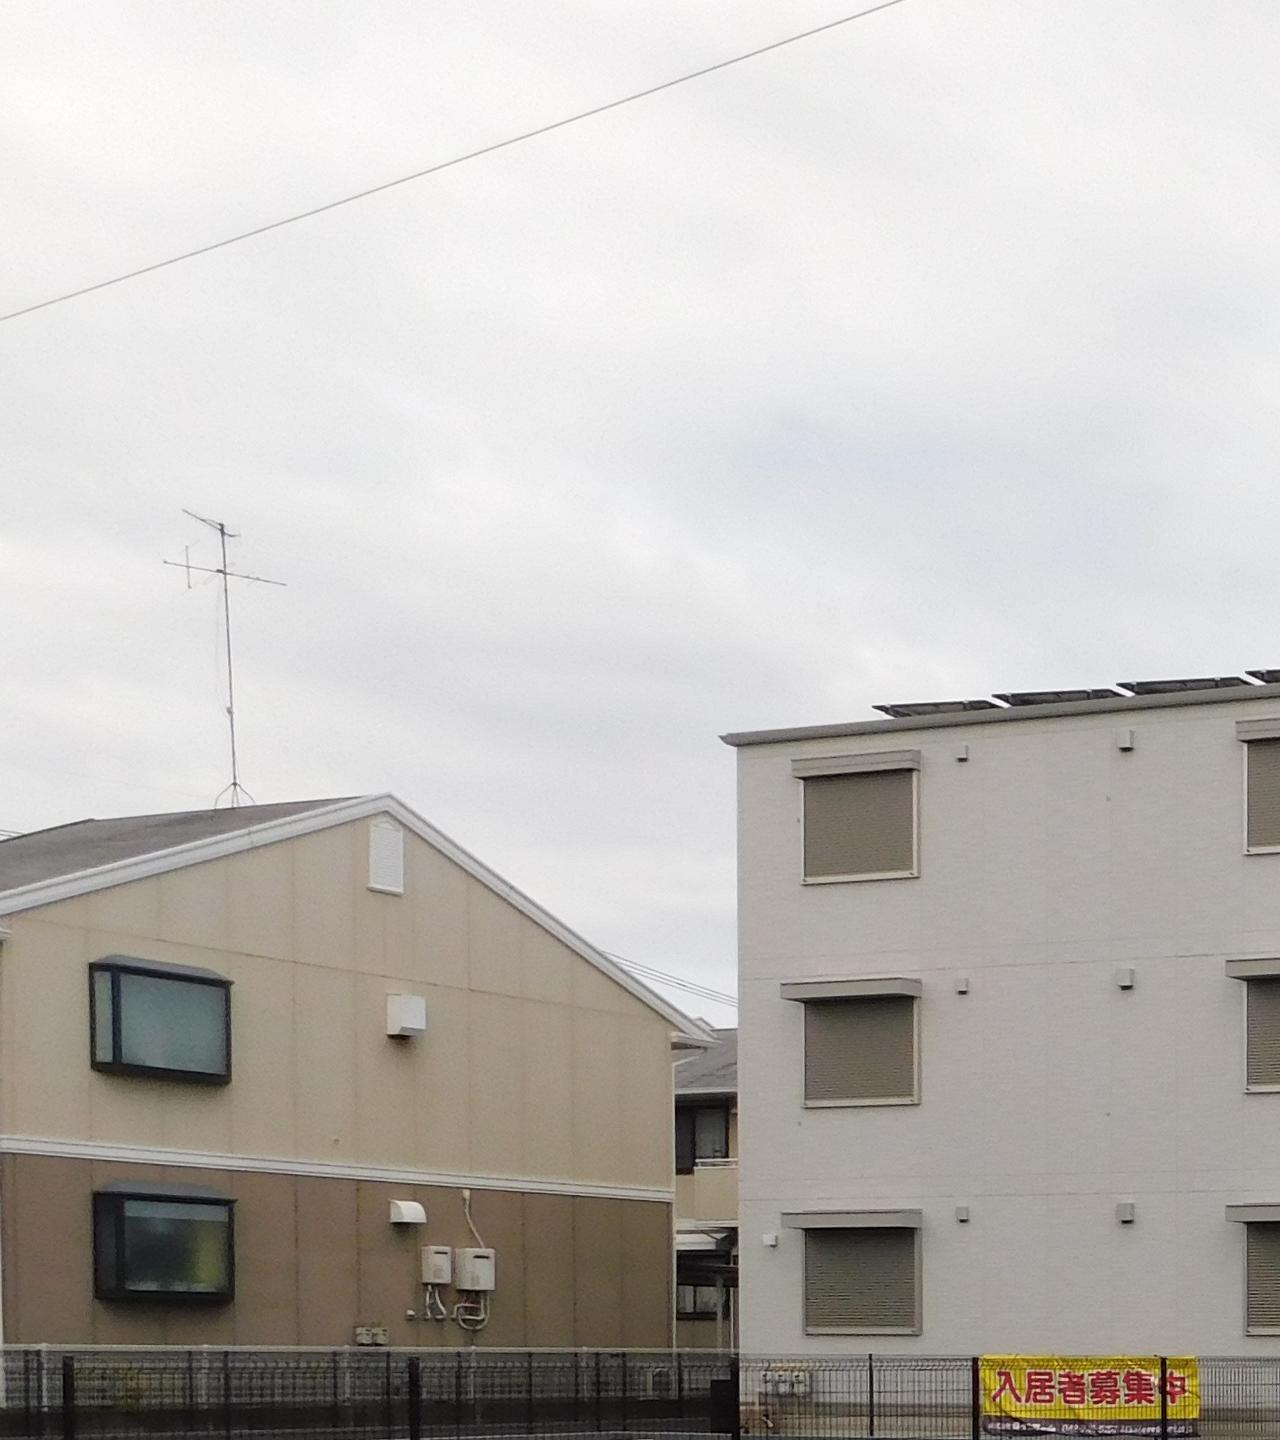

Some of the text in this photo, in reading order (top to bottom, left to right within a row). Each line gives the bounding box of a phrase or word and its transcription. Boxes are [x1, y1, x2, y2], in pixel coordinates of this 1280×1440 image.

[991, 1368, 1188, 1405] 入居者募集中
